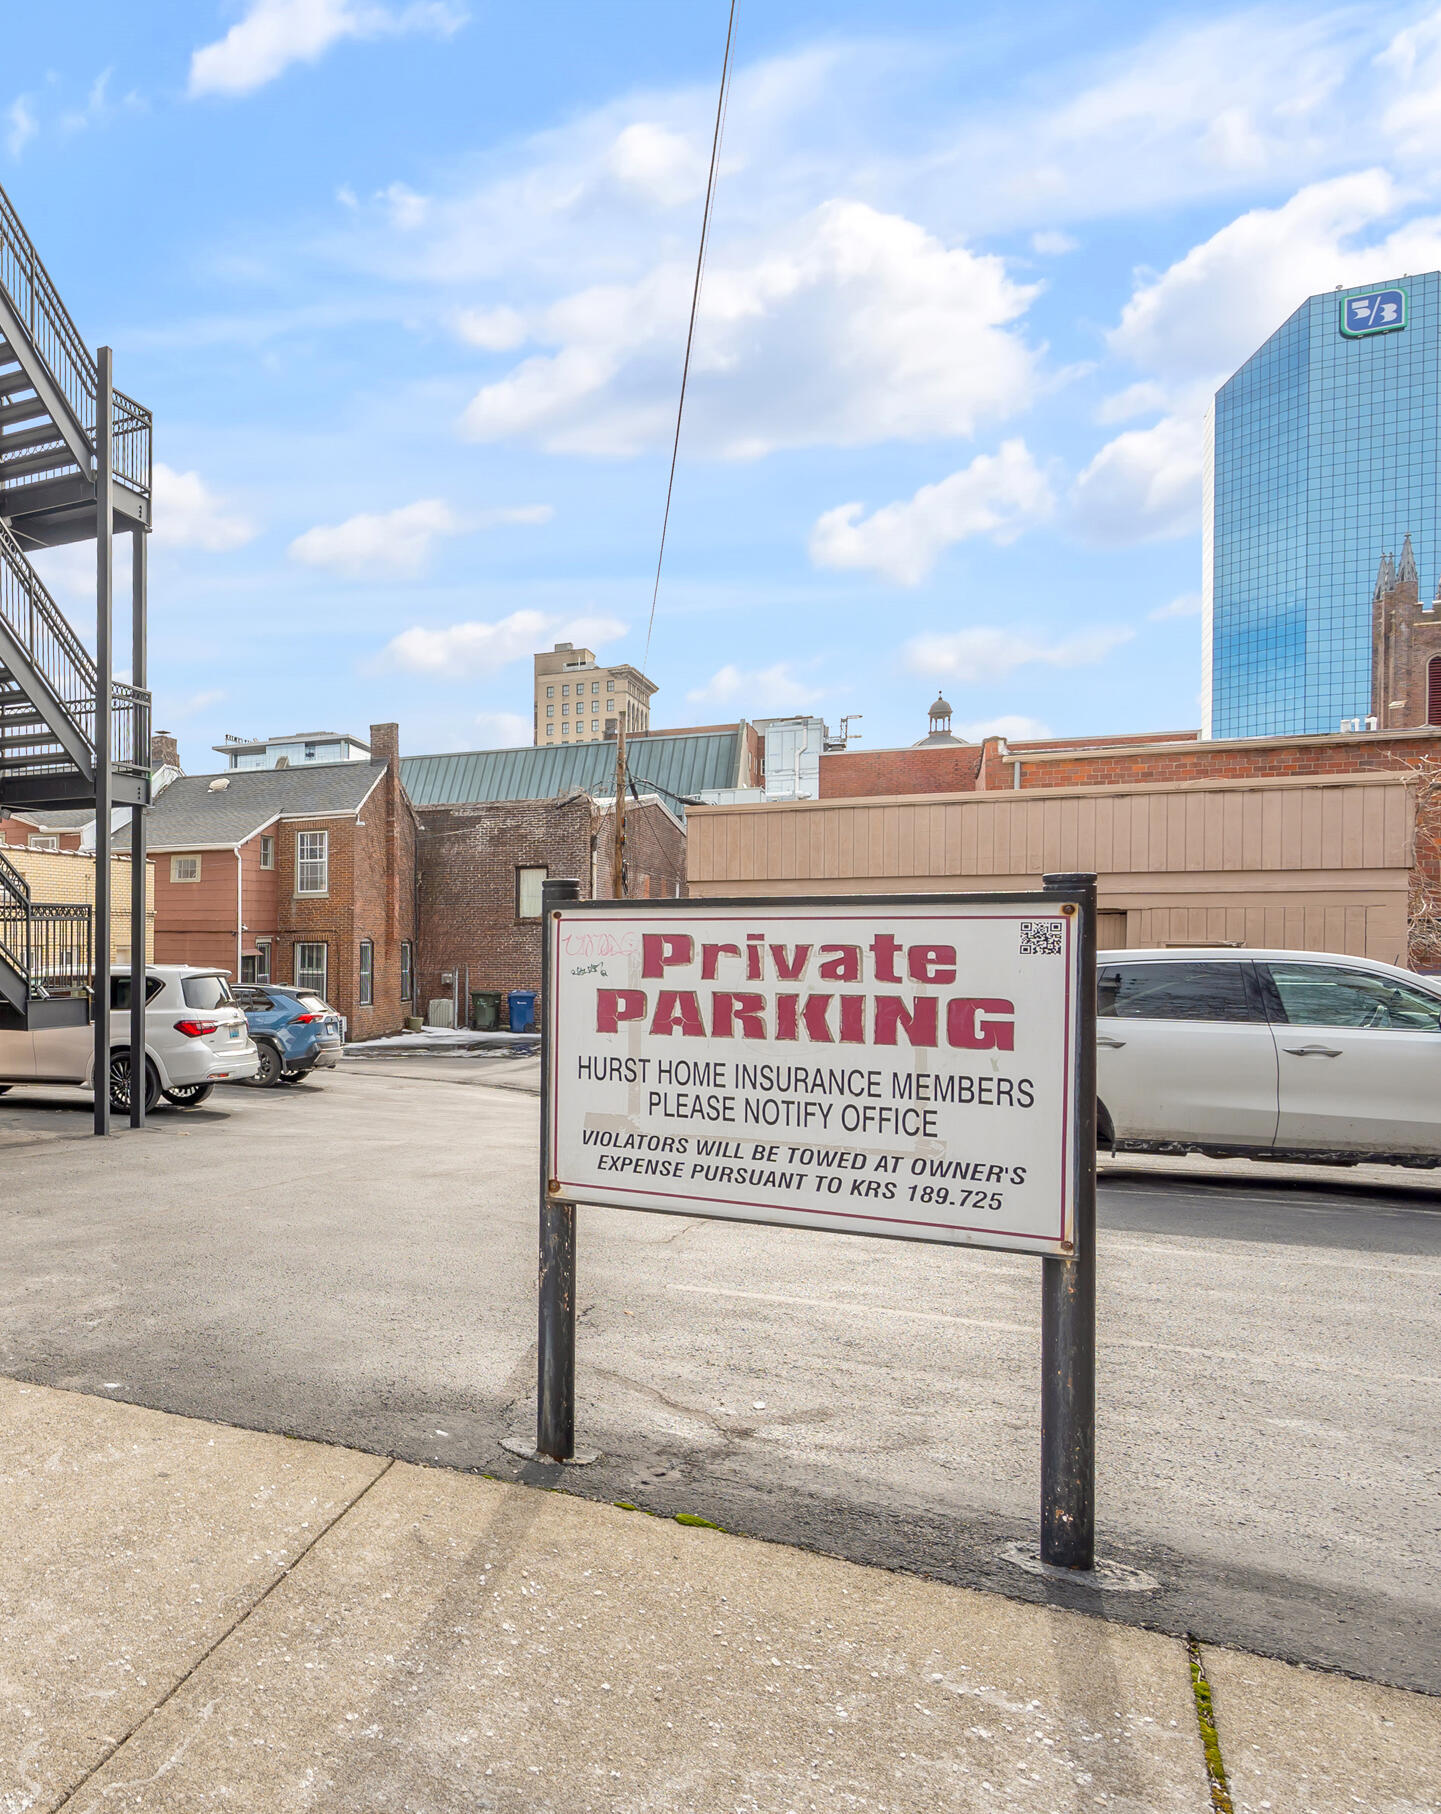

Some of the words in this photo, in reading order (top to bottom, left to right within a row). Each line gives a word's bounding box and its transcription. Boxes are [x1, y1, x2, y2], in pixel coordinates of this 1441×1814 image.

[642, 934, 957, 984] Private
[596, 989, 1015, 1051] PARKING
[578, 1055, 651, 1083] HURST
[658, 1059, 726, 1089] HOME
[735, 1063, 882, 1098] INSURANCE
[892, 1071, 1035, 1109] MEMBERS
[649, 1091, 736, 1123] PLEASE
[744, 1097, 834, 1130] NOTIFY
[841, 1103, 938, 1138] OFFICE
[582, 1129, 689, 1154] VIOLATORS
[696, 1139, 744, 1160] WILL
[751, 1144, 779, 1162] BE
[787, 1146, 867, 1170] TOWED
[873, 1155, 905, 1174] AT
[910, 1157, 1027, 1185] OWNER'S
[597, 1154, 686, 1178] EXPENSE
[690, 1163, 809, 1190] PURSUANT
[815, 1175, 843, 1194] TO
[849, 1178, 898, 1200] KRS
[908, 1184, 1004, 1211] 189.725
